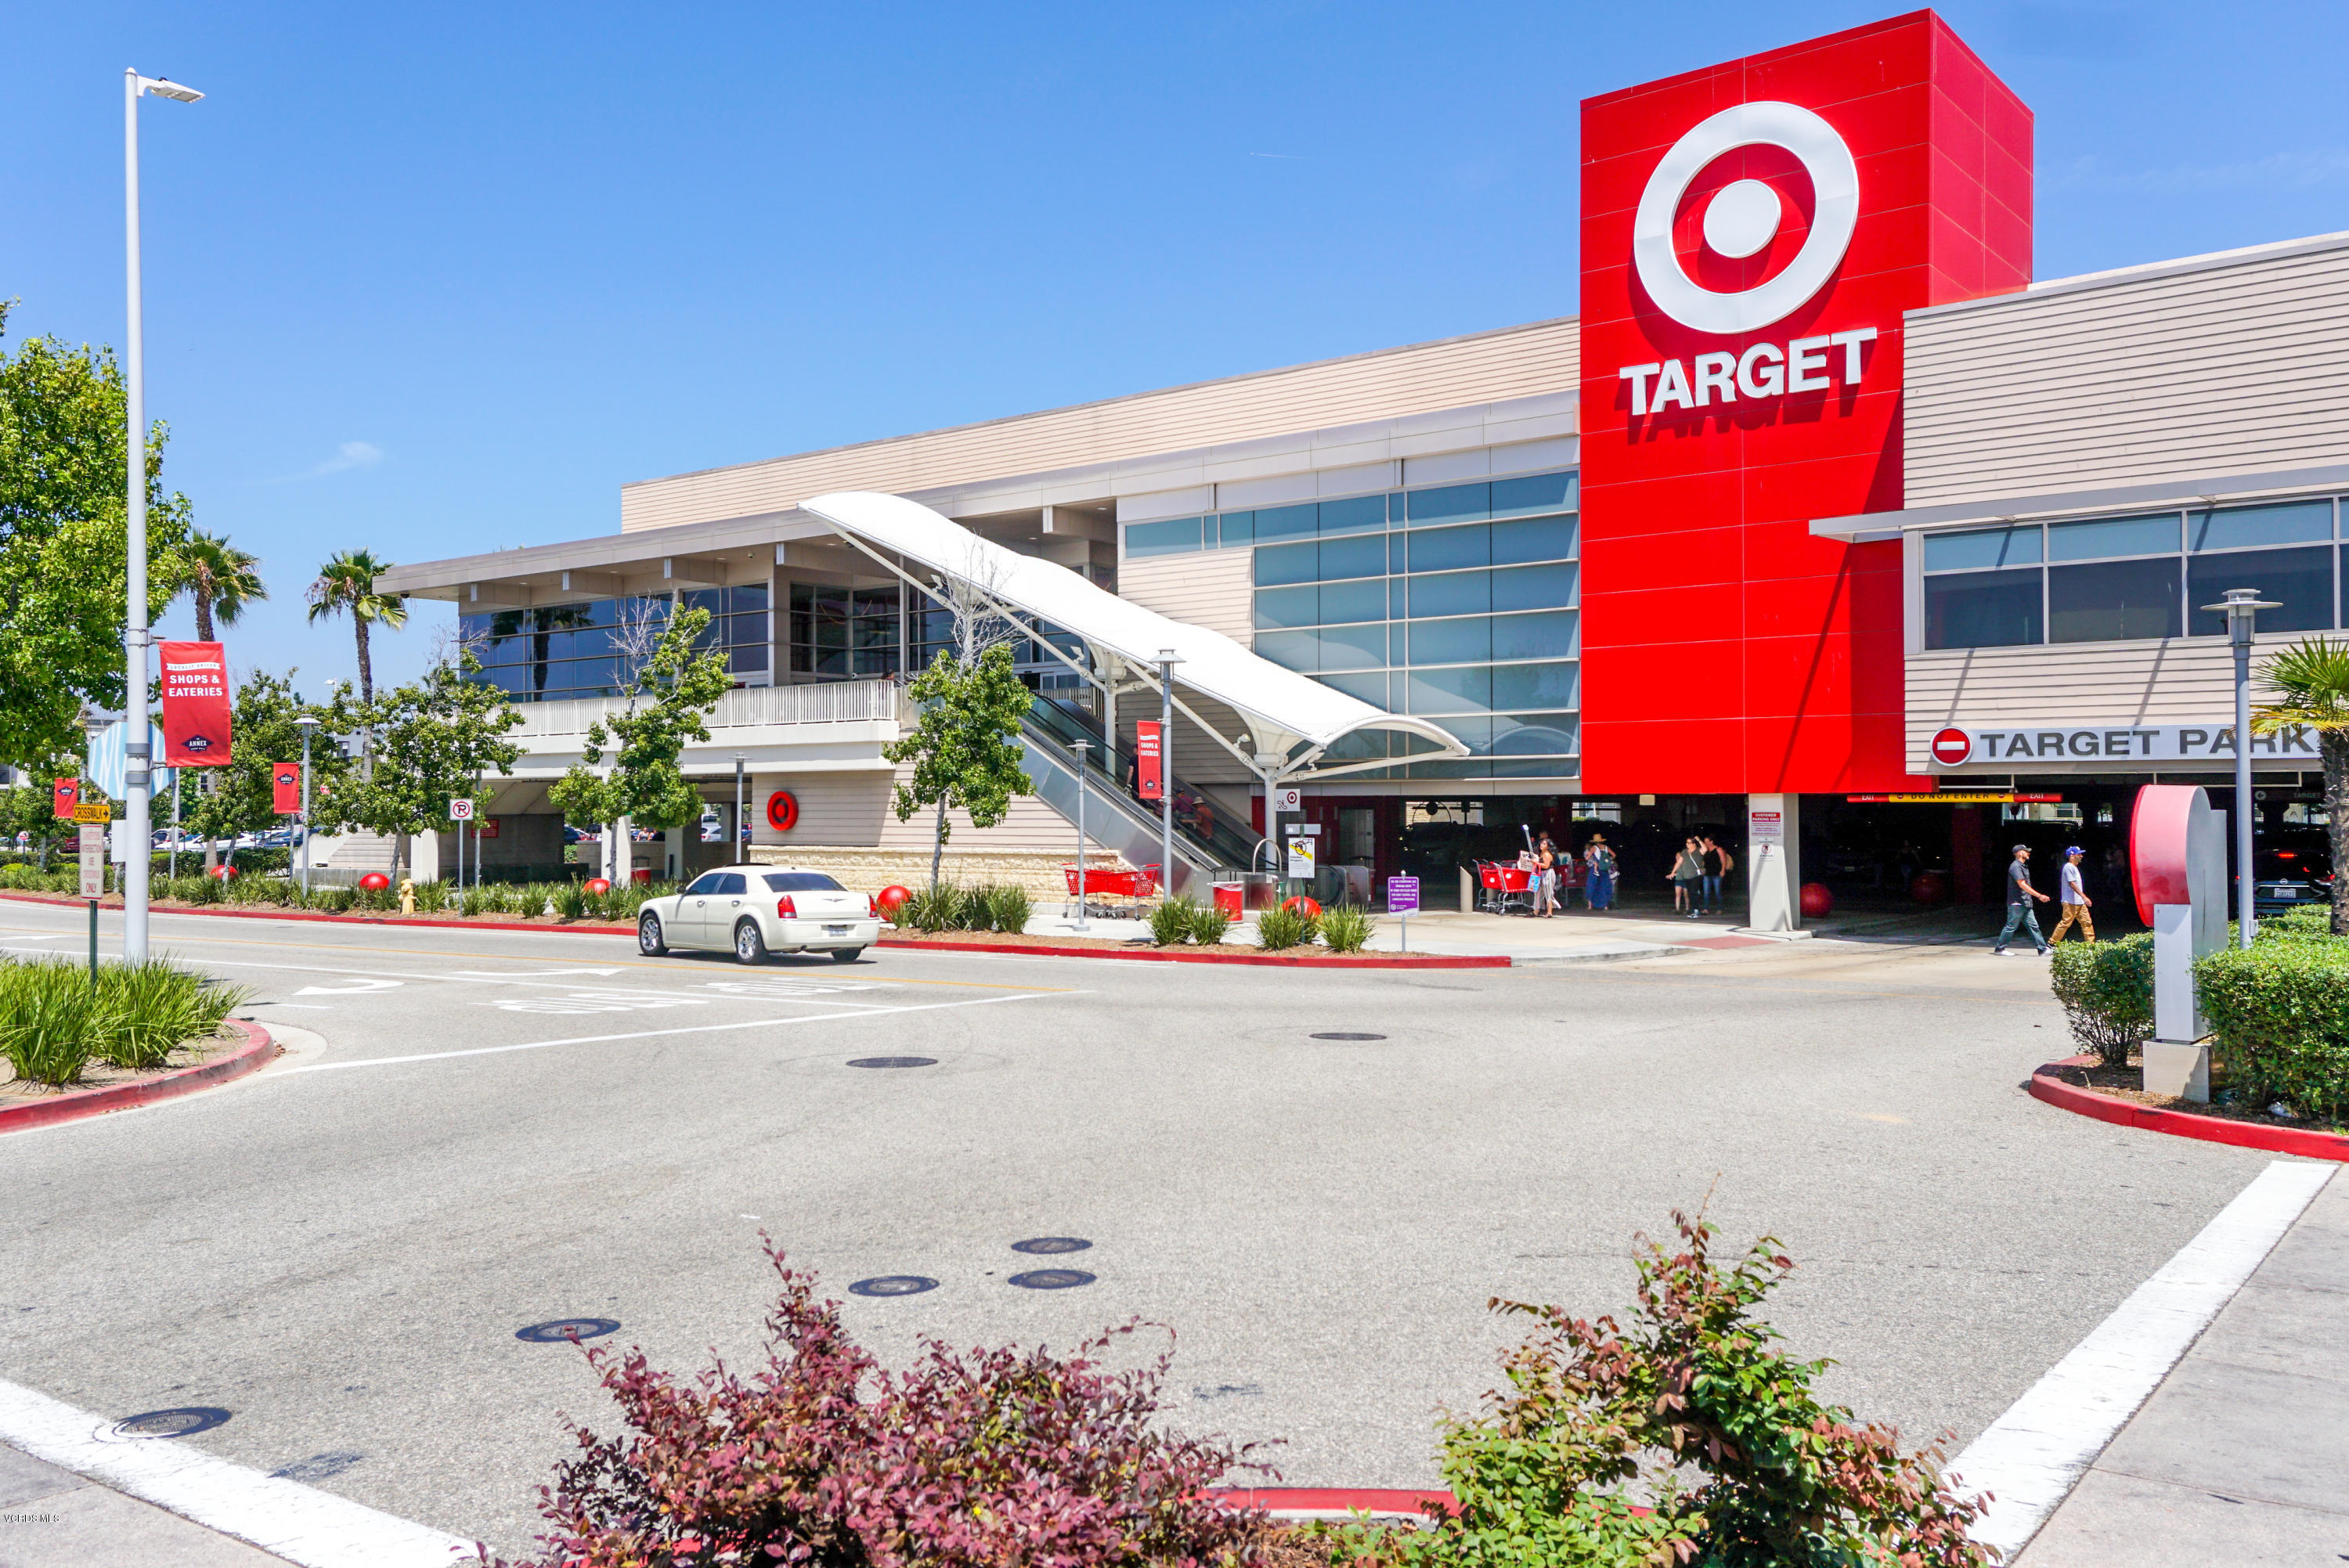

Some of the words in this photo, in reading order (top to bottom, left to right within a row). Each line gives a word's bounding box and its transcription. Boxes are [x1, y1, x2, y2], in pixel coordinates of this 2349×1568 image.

[1619, 327, 1877, 416] TARGET
[169, 675, 208, 684] SHOPS
[211, 675, 220, 684] &
[168, 687, 223, 697] EATERIES
[1980, 730, 2160, 758] TARGET
[74, 806, 103, 820] CROSSWALK
[85, 882, 97, 893] ONLY
